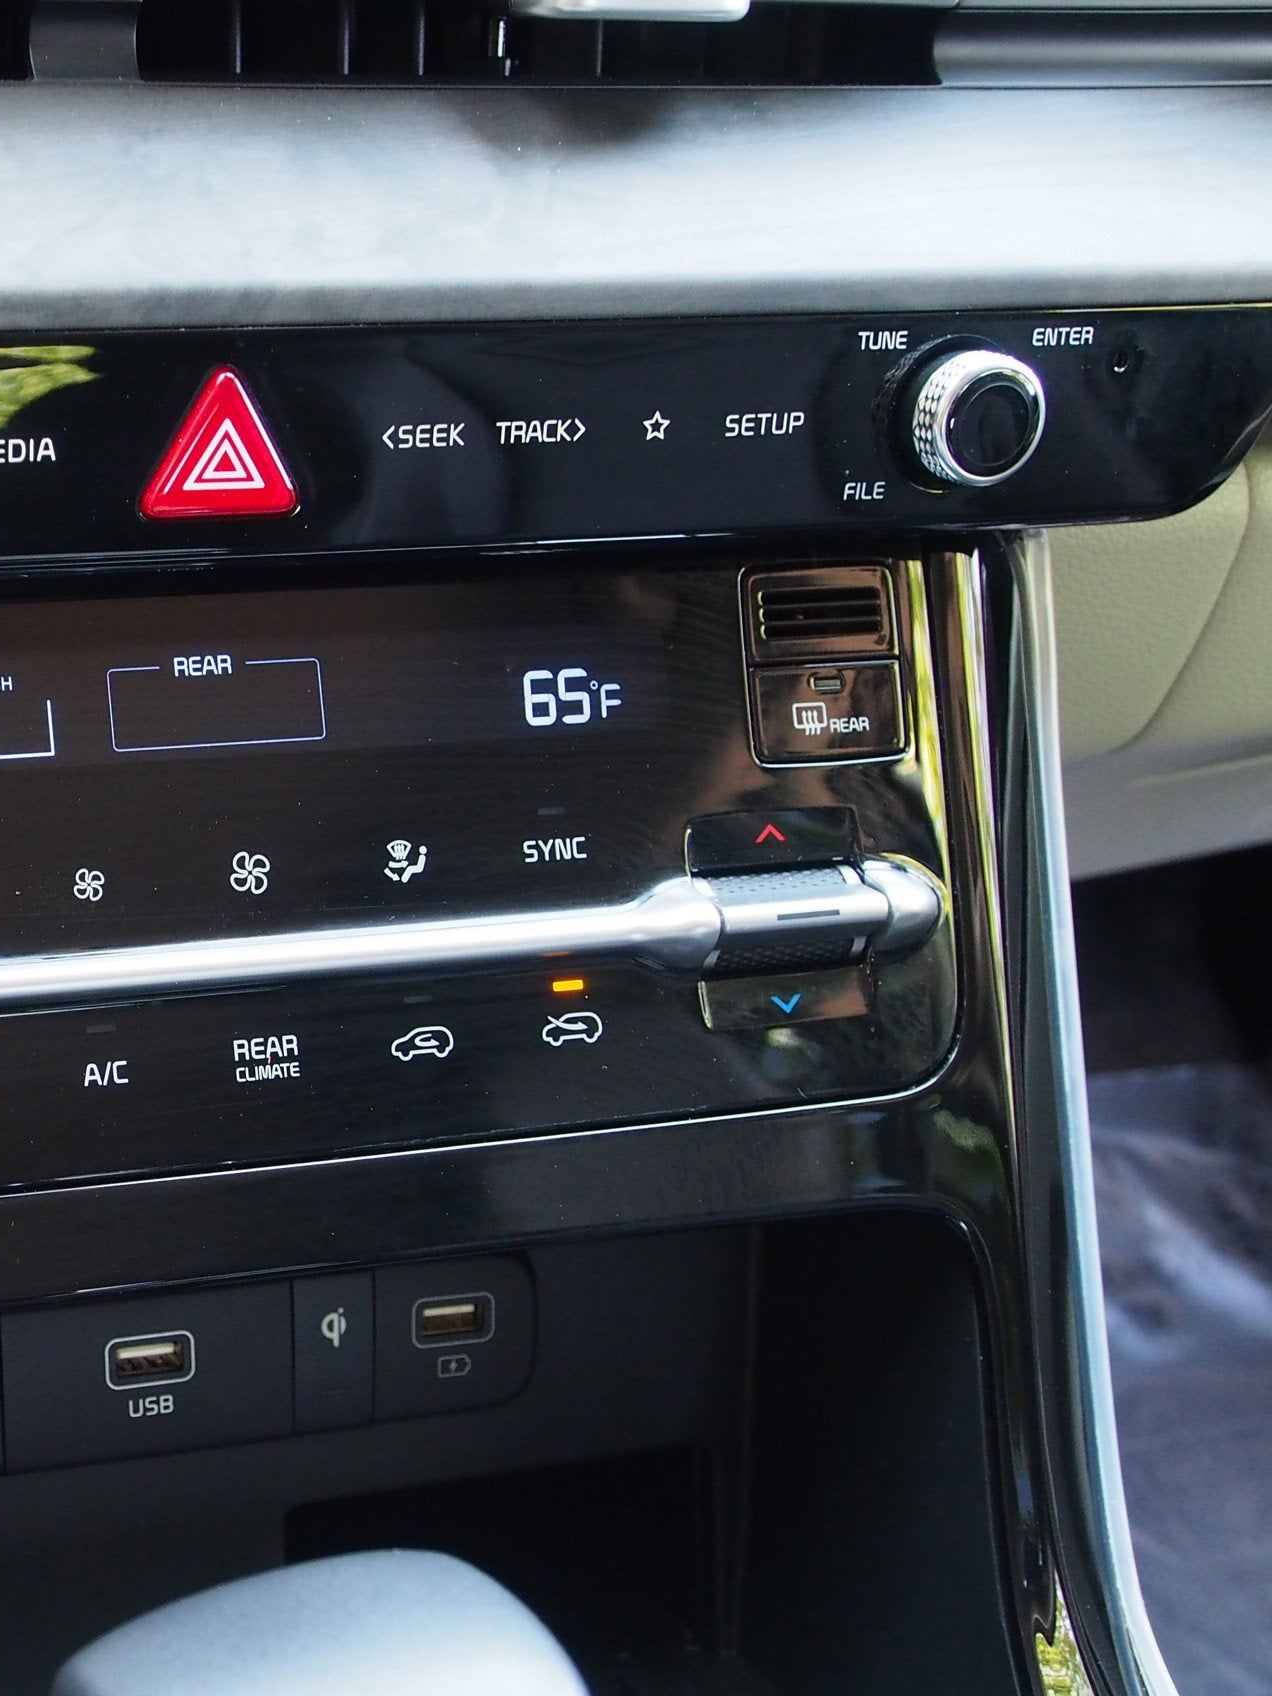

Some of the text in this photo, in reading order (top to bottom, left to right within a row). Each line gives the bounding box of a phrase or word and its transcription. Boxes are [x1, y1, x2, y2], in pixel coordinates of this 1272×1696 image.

[858, 330, 909, 351] TUNE
[1032, 326, 1094, 347] ENTER
[724, 411, 805, 438] SETUP
[843, 481, 886, 502] FILE
[173, 654, 233, 678] REAR
[829, 716, 870, 734] REAR
[523, 836, 588, 864] SYNC
[233, 1034, 299, 1062] REAR
[84, 1060, 129, 1087] A/C
[235, 1061, 301, 1083] CLIMATE
[128, 1395, 175, 1418] USB
